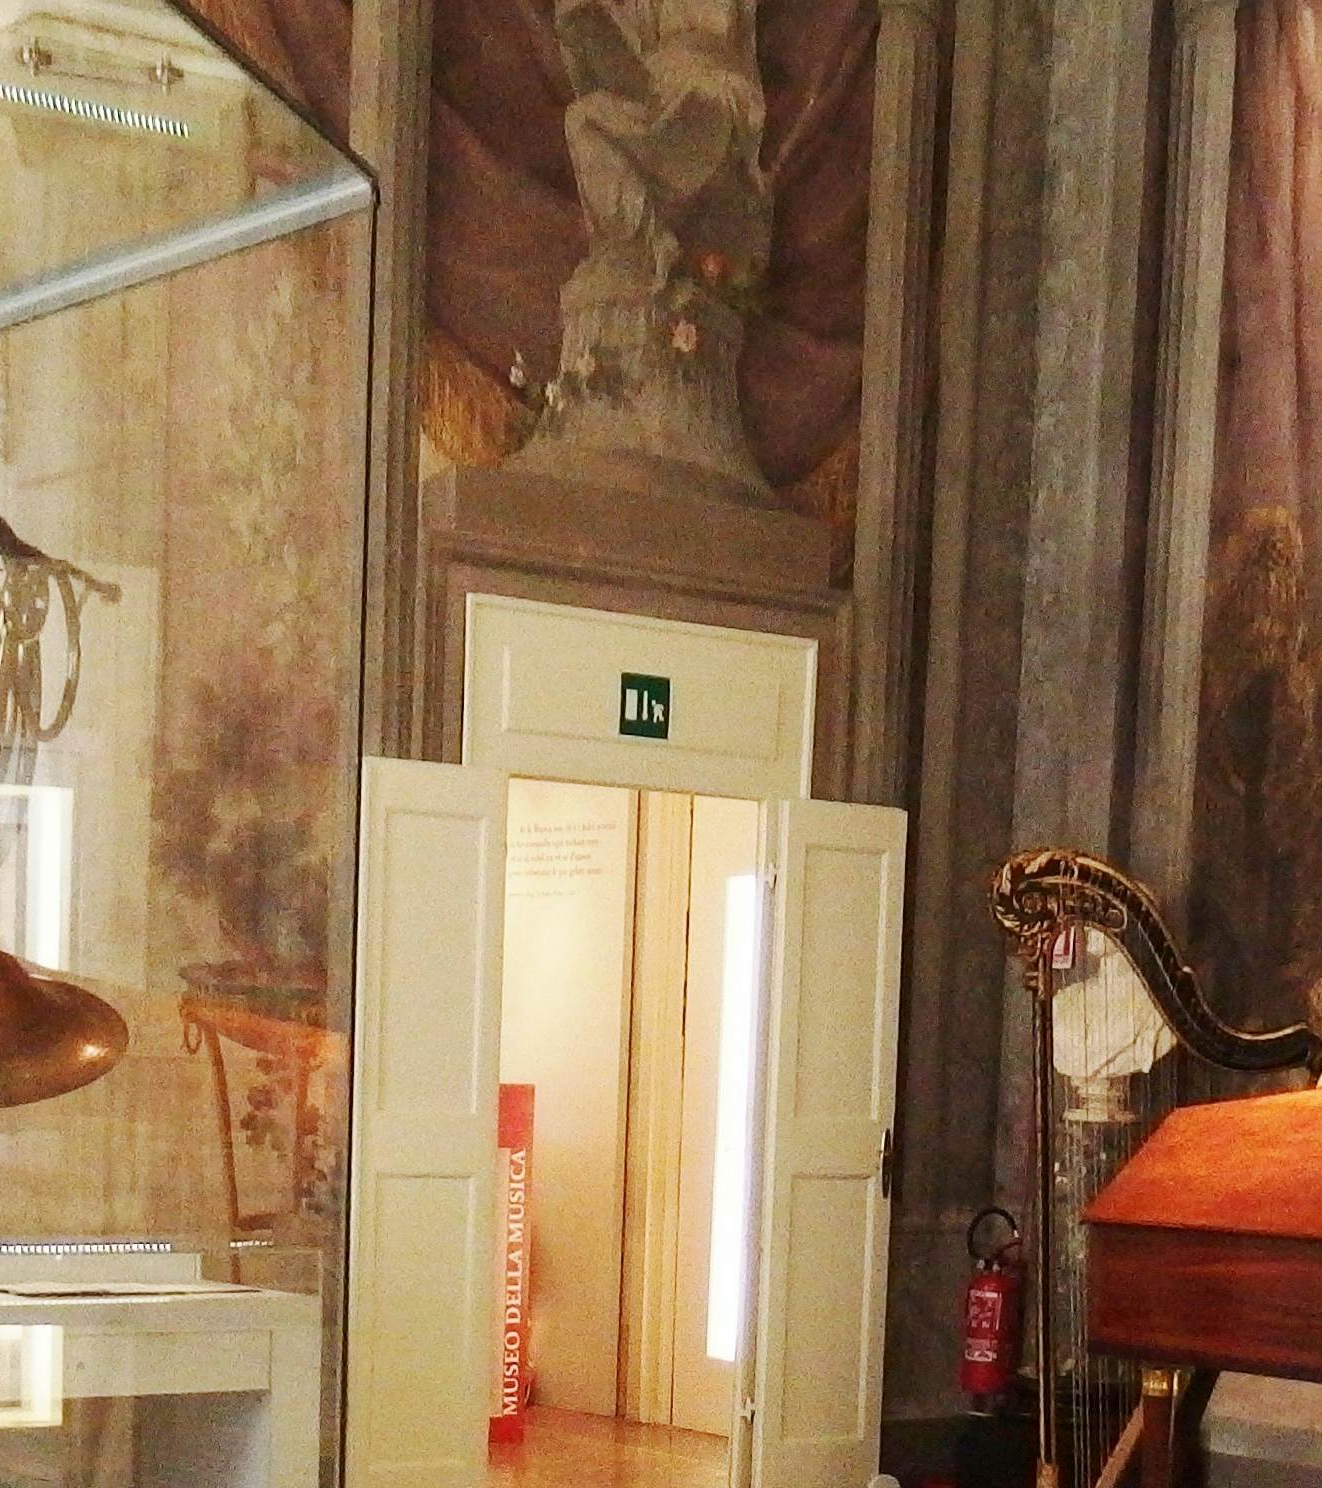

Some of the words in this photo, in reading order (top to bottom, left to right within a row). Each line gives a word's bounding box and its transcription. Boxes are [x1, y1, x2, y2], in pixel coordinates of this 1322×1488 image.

[509, 1149, 527, 1242] MUSICA
[506, 1248, 523, 1325] DELLA
[503, 1330, 521, 1415] MUSEO
